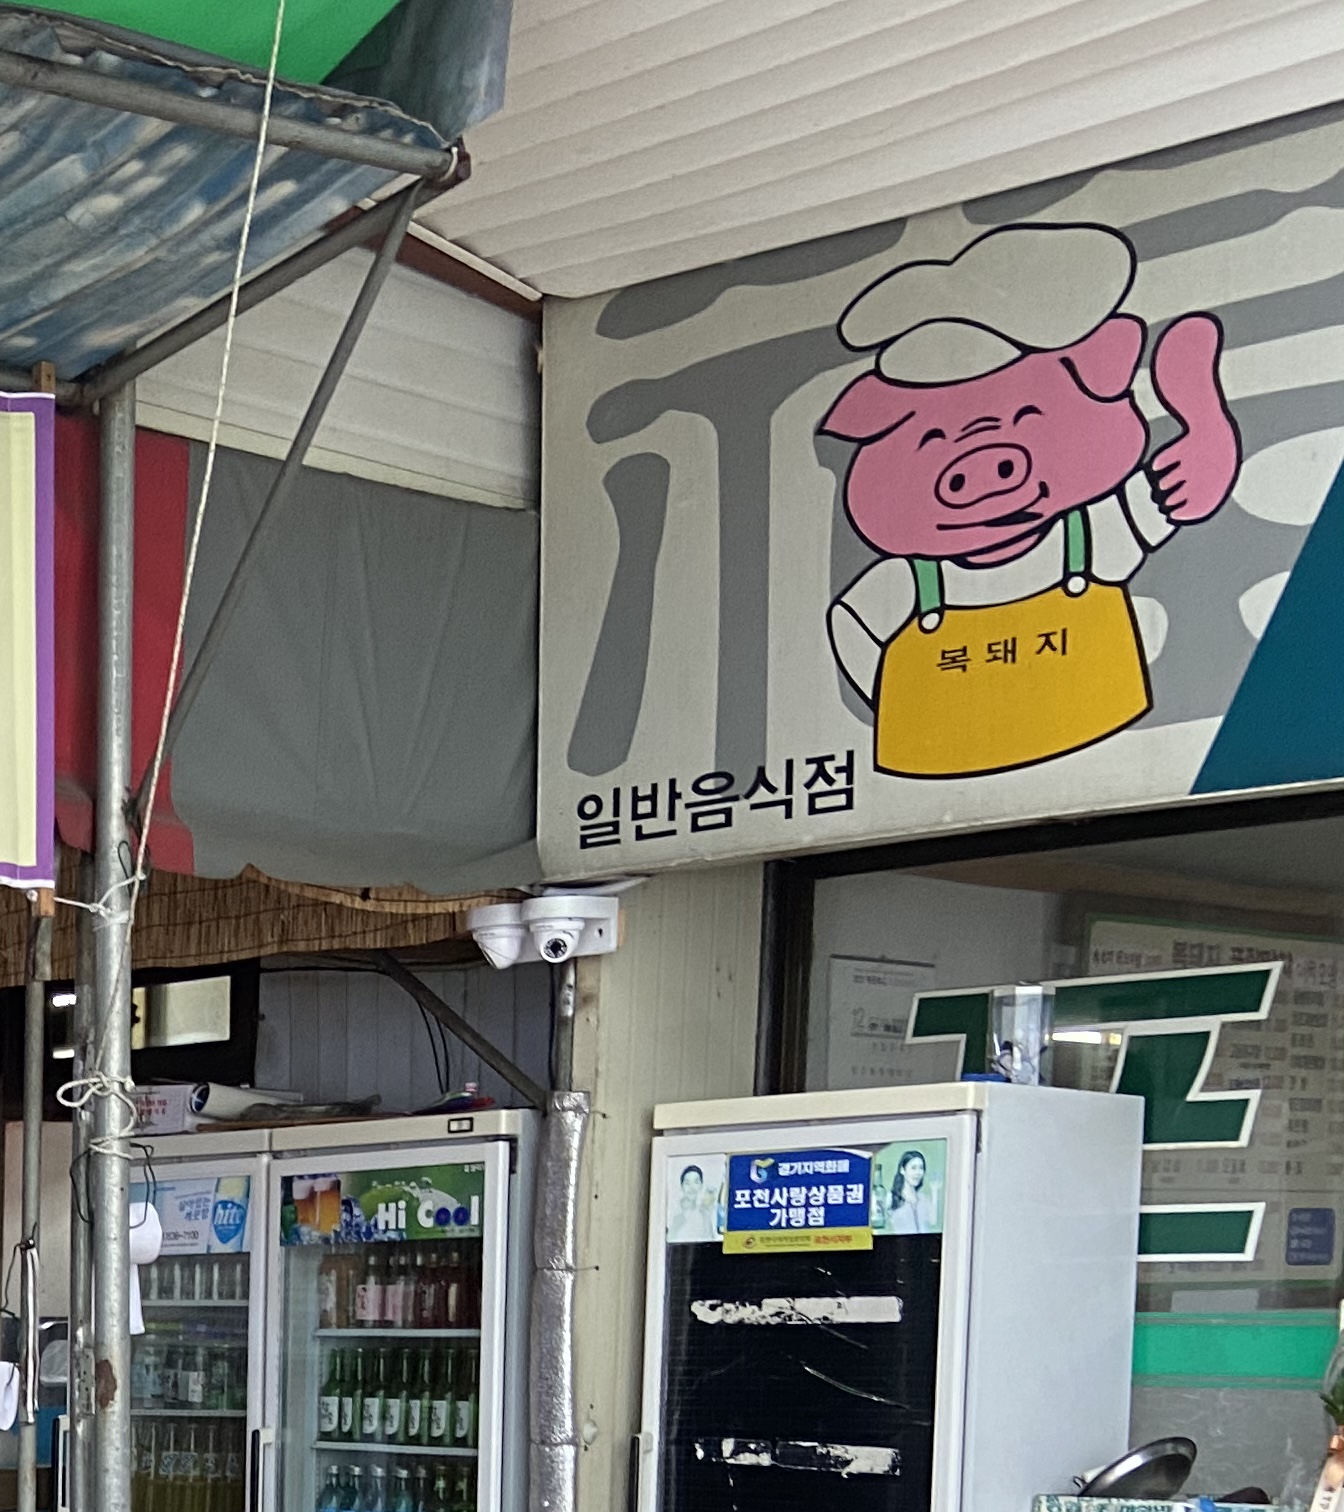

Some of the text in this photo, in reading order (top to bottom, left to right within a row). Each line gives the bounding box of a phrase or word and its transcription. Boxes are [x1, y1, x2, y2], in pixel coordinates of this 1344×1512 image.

[574, 750, 858, 851] 일반음식점
[734, 1184, 864, 1209] 포천사랑상품권
[377, 1195, 480, 1231] Hi Cool
[769, 1207, 825, 1227] 가맹점
